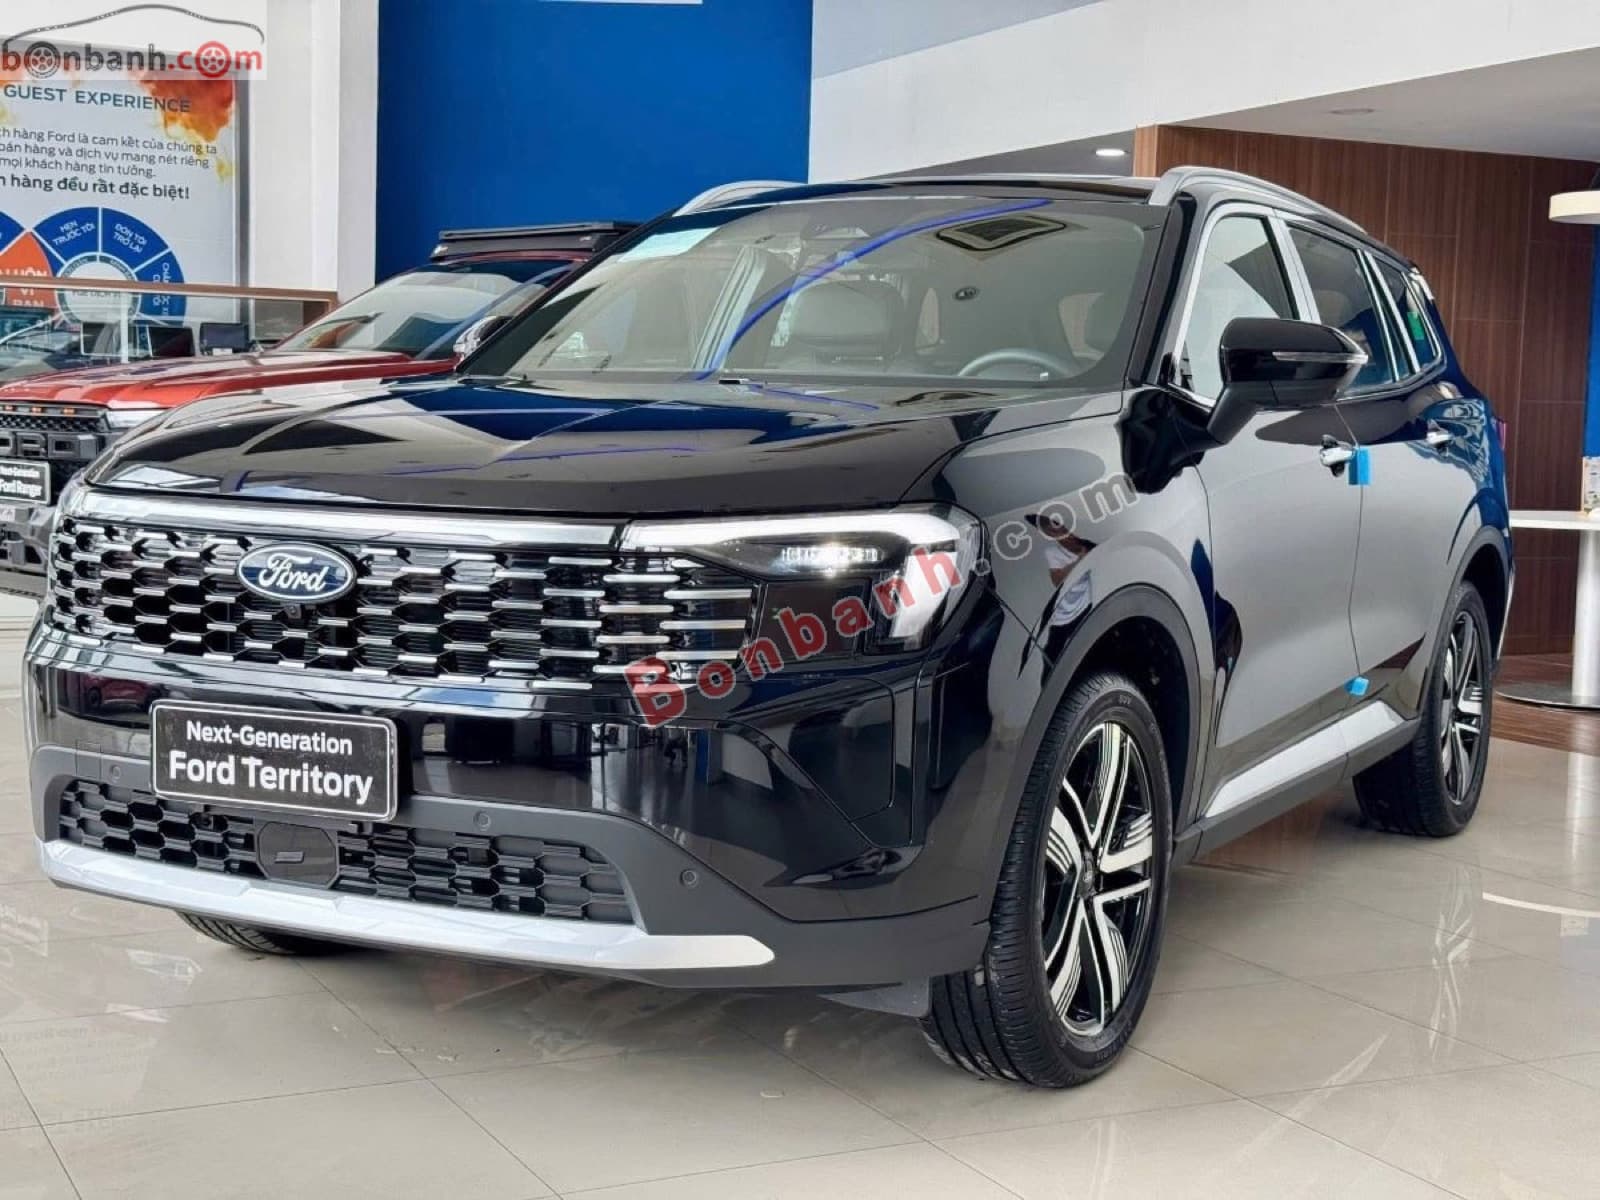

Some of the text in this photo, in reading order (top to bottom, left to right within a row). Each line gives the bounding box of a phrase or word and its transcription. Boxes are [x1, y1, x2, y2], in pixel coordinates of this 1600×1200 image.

[3, 84, 191, 112] GUEST EXPERIENCE
[13, 128, 45, 143] hàng
[47, 131, 75, 143] Ford
[78, 132, 89, 144] là
[91, 136, 118, 146] cam
[142, 138, 163, 150] của
[206, 143, 217, 154] ta
[24, 143, 56, 157] hàng
[58, 147, 73, 157] và
[75, 147, 101, 160] dịch
[121, 152, 156, 165] mang
[159, 153, 177, 165] nét
[25, 157, 63, 170] khách
[65, 160, 96, 175] hàng
[99, 163, 114, 174] tin
[11, 173, 53, 192] hàng
[119, 182, 149, 198] đặc
[153, 184, 190, 200] biệt!
[258, 552, 330, 592] Ford
[186, 720, 352, 756] Next-Generation
[169, 750, 373, 805] Ford Territory
